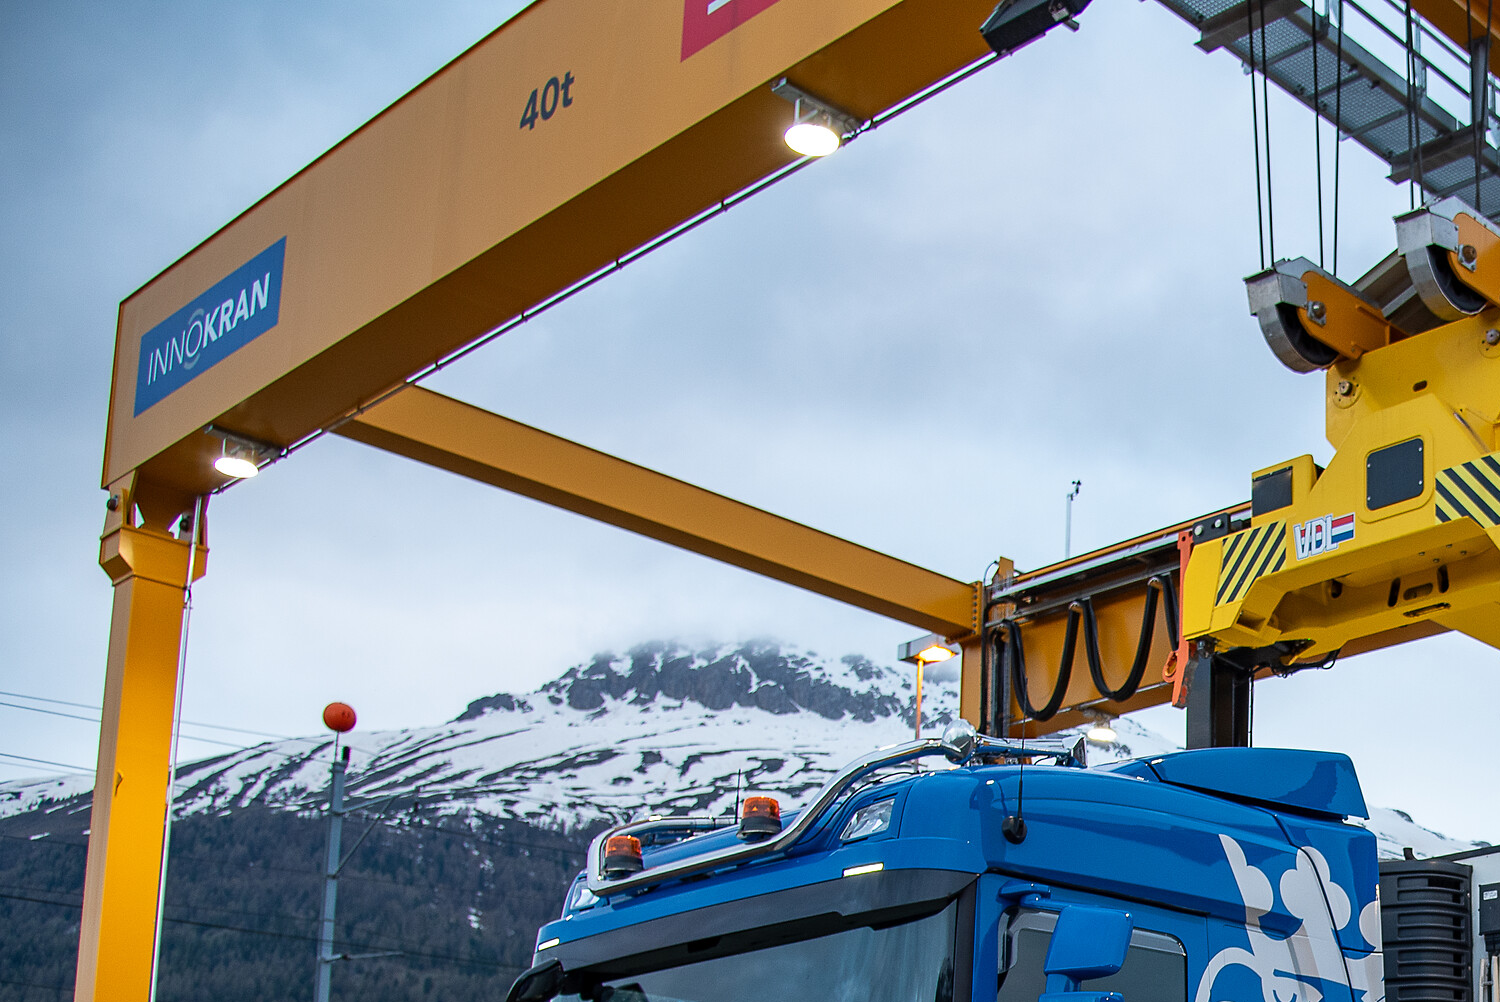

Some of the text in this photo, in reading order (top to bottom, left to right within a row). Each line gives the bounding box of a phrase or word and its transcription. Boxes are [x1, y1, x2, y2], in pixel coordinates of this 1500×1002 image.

[519, 70, 575, 131] 40t
[147, 271, 271, 386] INNOKRAN
[1293, 512, 1340, 561] VDL
